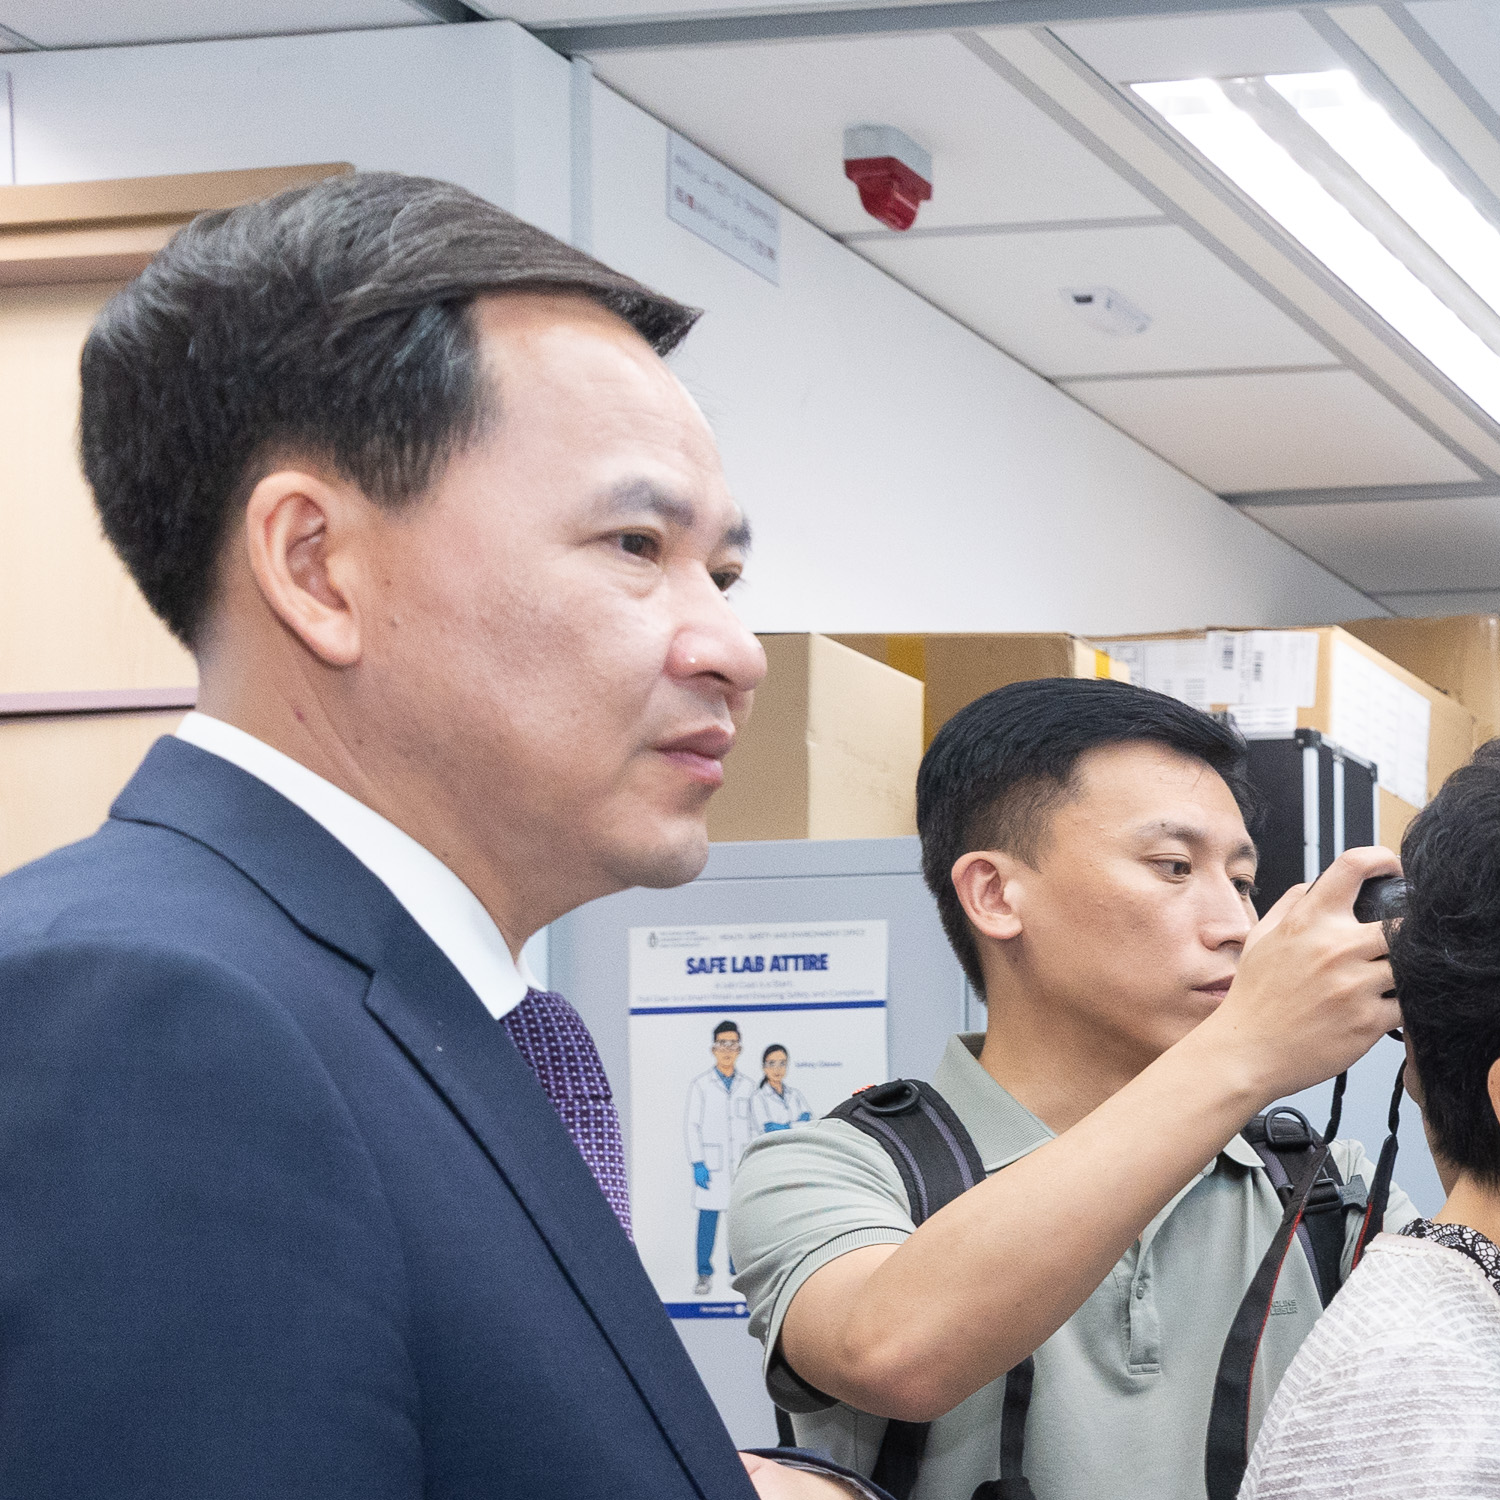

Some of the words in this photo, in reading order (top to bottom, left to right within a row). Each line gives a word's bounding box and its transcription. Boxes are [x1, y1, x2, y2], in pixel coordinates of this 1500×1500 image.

[686, 957, 727, 974] SAFE
[731, 955, 764, 973] LAB
[769, 953, 828, 972] ATTIRE
